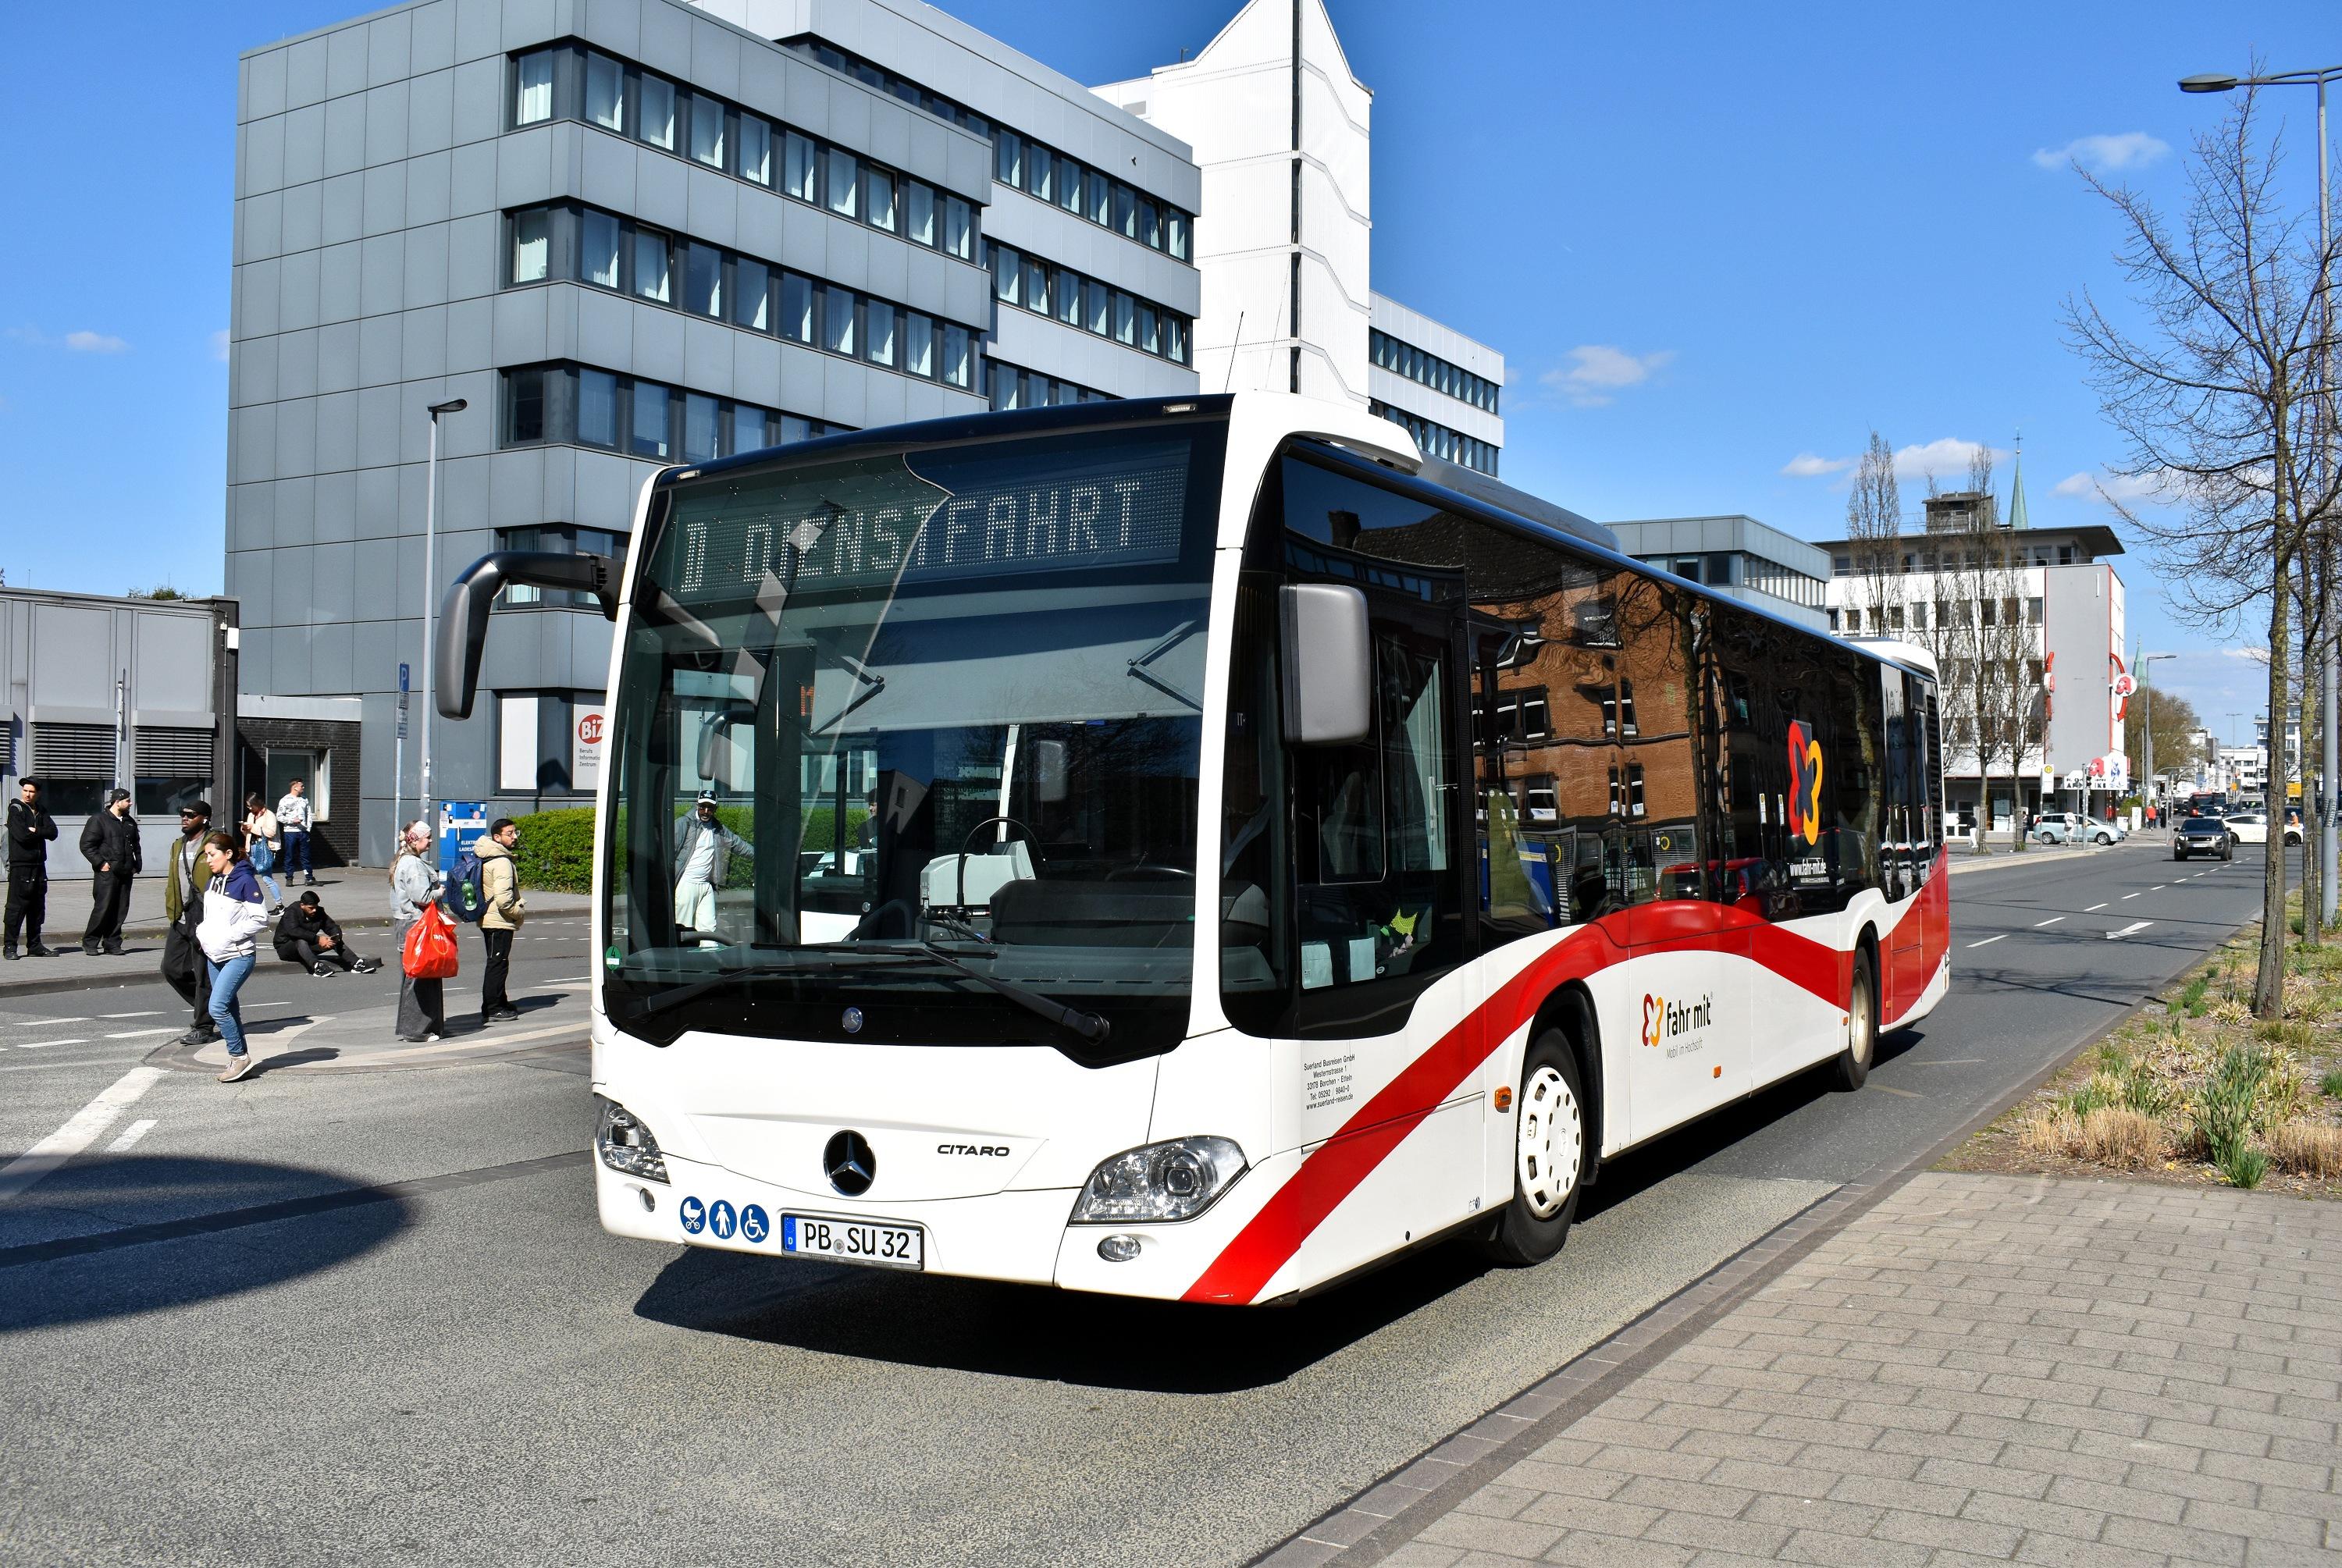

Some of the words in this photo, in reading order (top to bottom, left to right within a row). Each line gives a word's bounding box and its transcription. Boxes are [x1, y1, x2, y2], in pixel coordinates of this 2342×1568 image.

[743, 481, 1141, 582] DIENSTFAHRT
[400, 667, 408, 689] P
[1667, 1000, 1691, 1038] fahr
[1693, 994, 1711, 1029] mit
[1304, 1060, 1322, 1071] Suerland
[1322, 1057, 1343, 1067] Busreisen
[1343, 1054, 1355, 1063] GmbH
[1312, 1067, 1344, 1078] Westernstrasse
[1319, 1078, 1337, 1088] Borchen
[1306, 1093, 1354, 1110] www.suerland-reisen.de
[937, 1144, 1011, 1157] CITARO
[788, 1236, 793, 1246] D
[804, 1222, 832, 1250] PB
[847, 1227, 876, 1256] SU
[881, 1230, 910, 1259] 32
